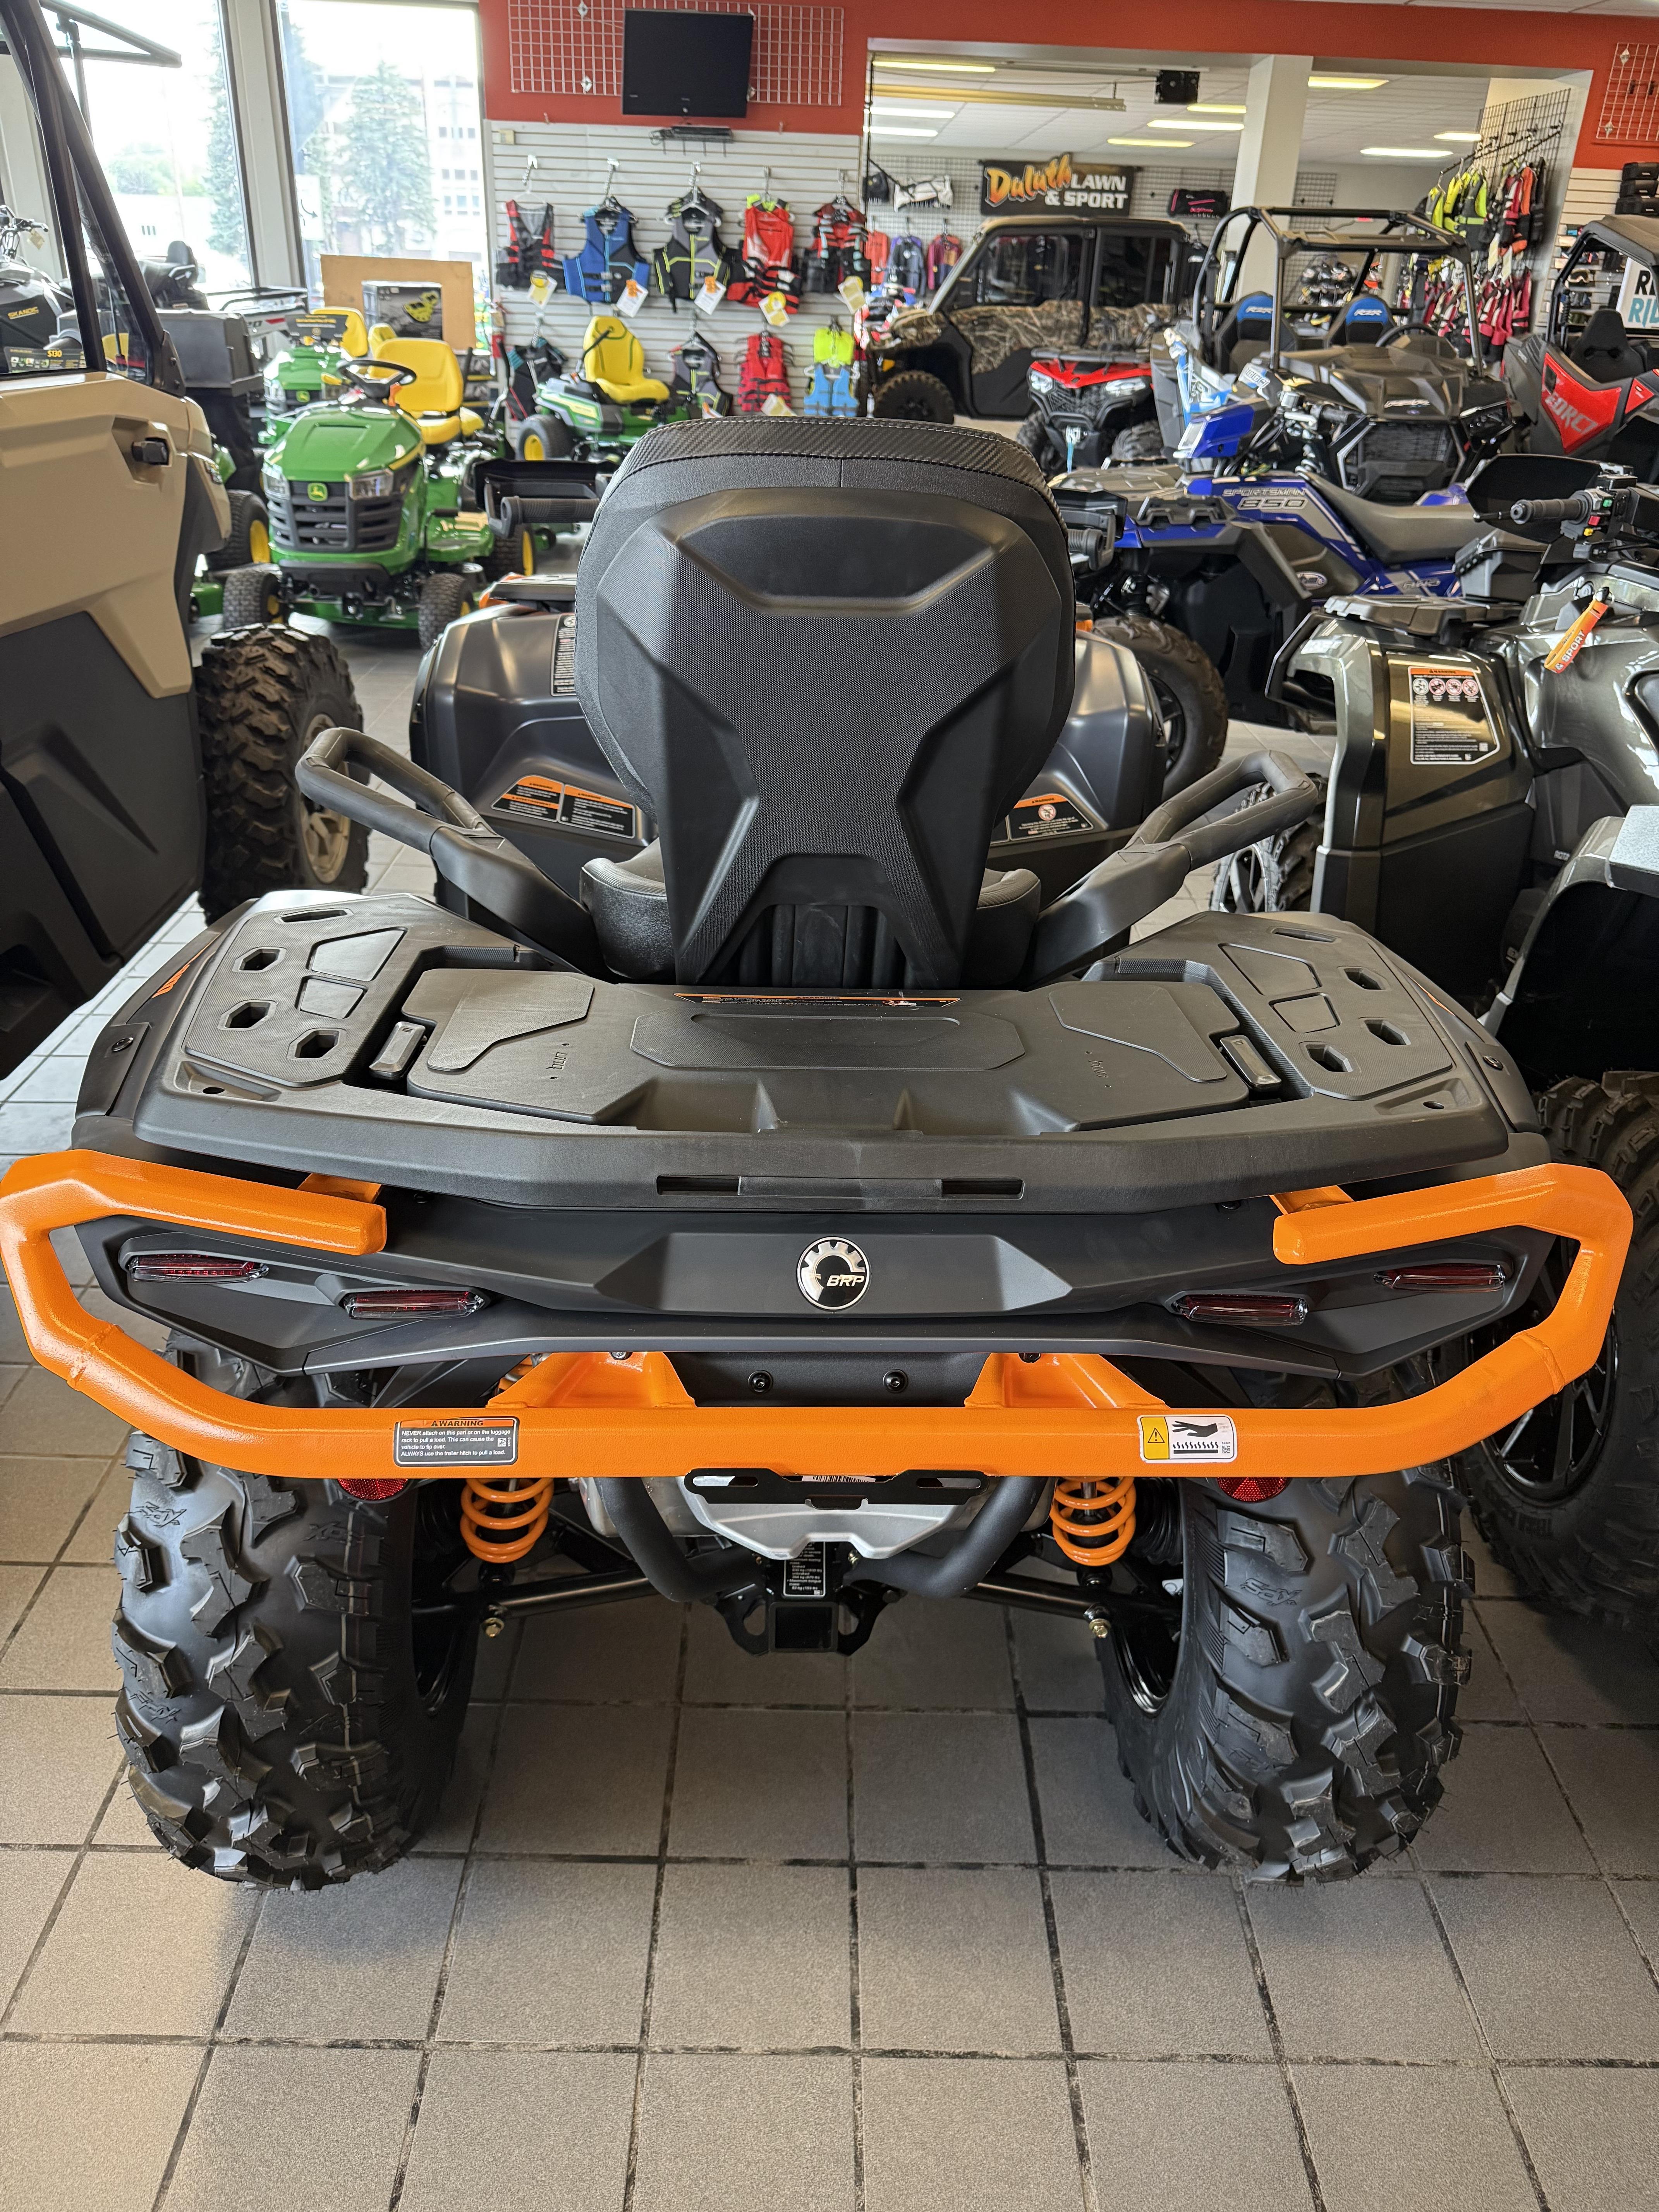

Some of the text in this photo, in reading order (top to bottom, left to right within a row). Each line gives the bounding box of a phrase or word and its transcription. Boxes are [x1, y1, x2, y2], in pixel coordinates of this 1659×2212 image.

[986, 154, 1127, 204] Duluth LAWN
[1044, 191, 1128, 210] & SPORT
[1222, 487, 1306, 497] SPORTSMAN
[1561, 630, 1585, 662] SPORT
[826, 1274, 865, 1287] BRP
